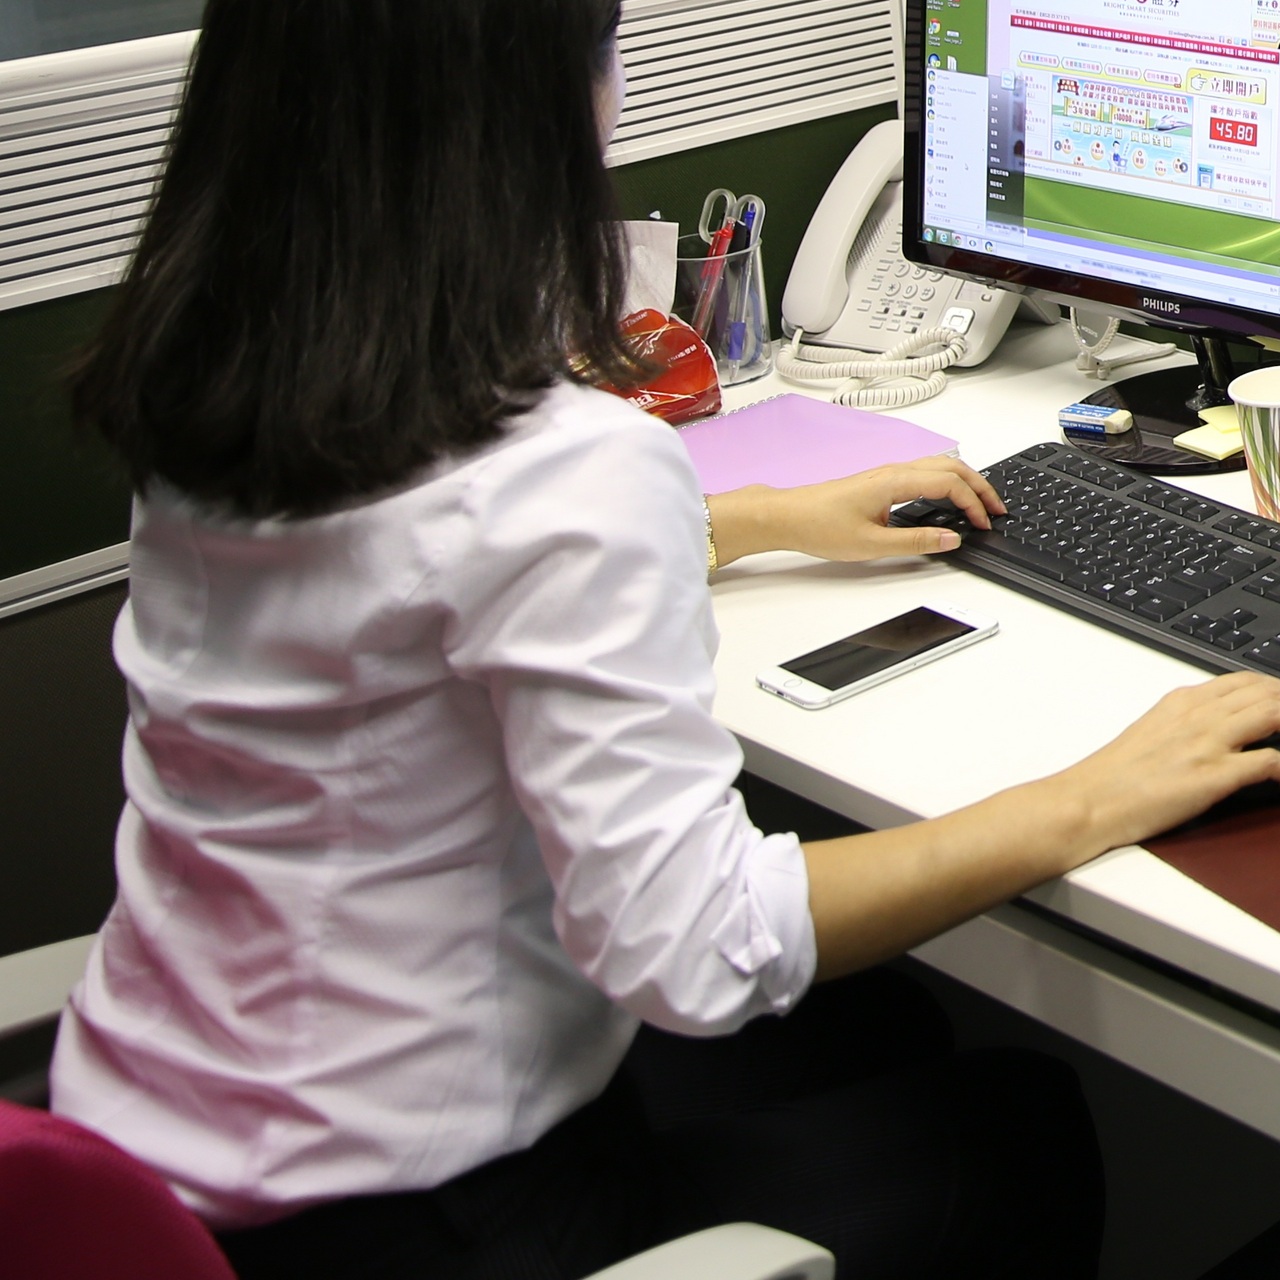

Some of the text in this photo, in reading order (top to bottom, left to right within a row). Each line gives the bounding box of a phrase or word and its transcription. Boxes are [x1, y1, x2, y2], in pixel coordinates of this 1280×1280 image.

[1103, 1, 1126, 10] BRIGHT
[1126, 4, 1147, 13] SMART
[1148, 7, 1180, 18] SECURITIES
[1210, 77, 1260, 97] 立即開戶
[1215, 122, 1254, 142] 45.80
[1142, 297, 1181, 315] PHILIPS
